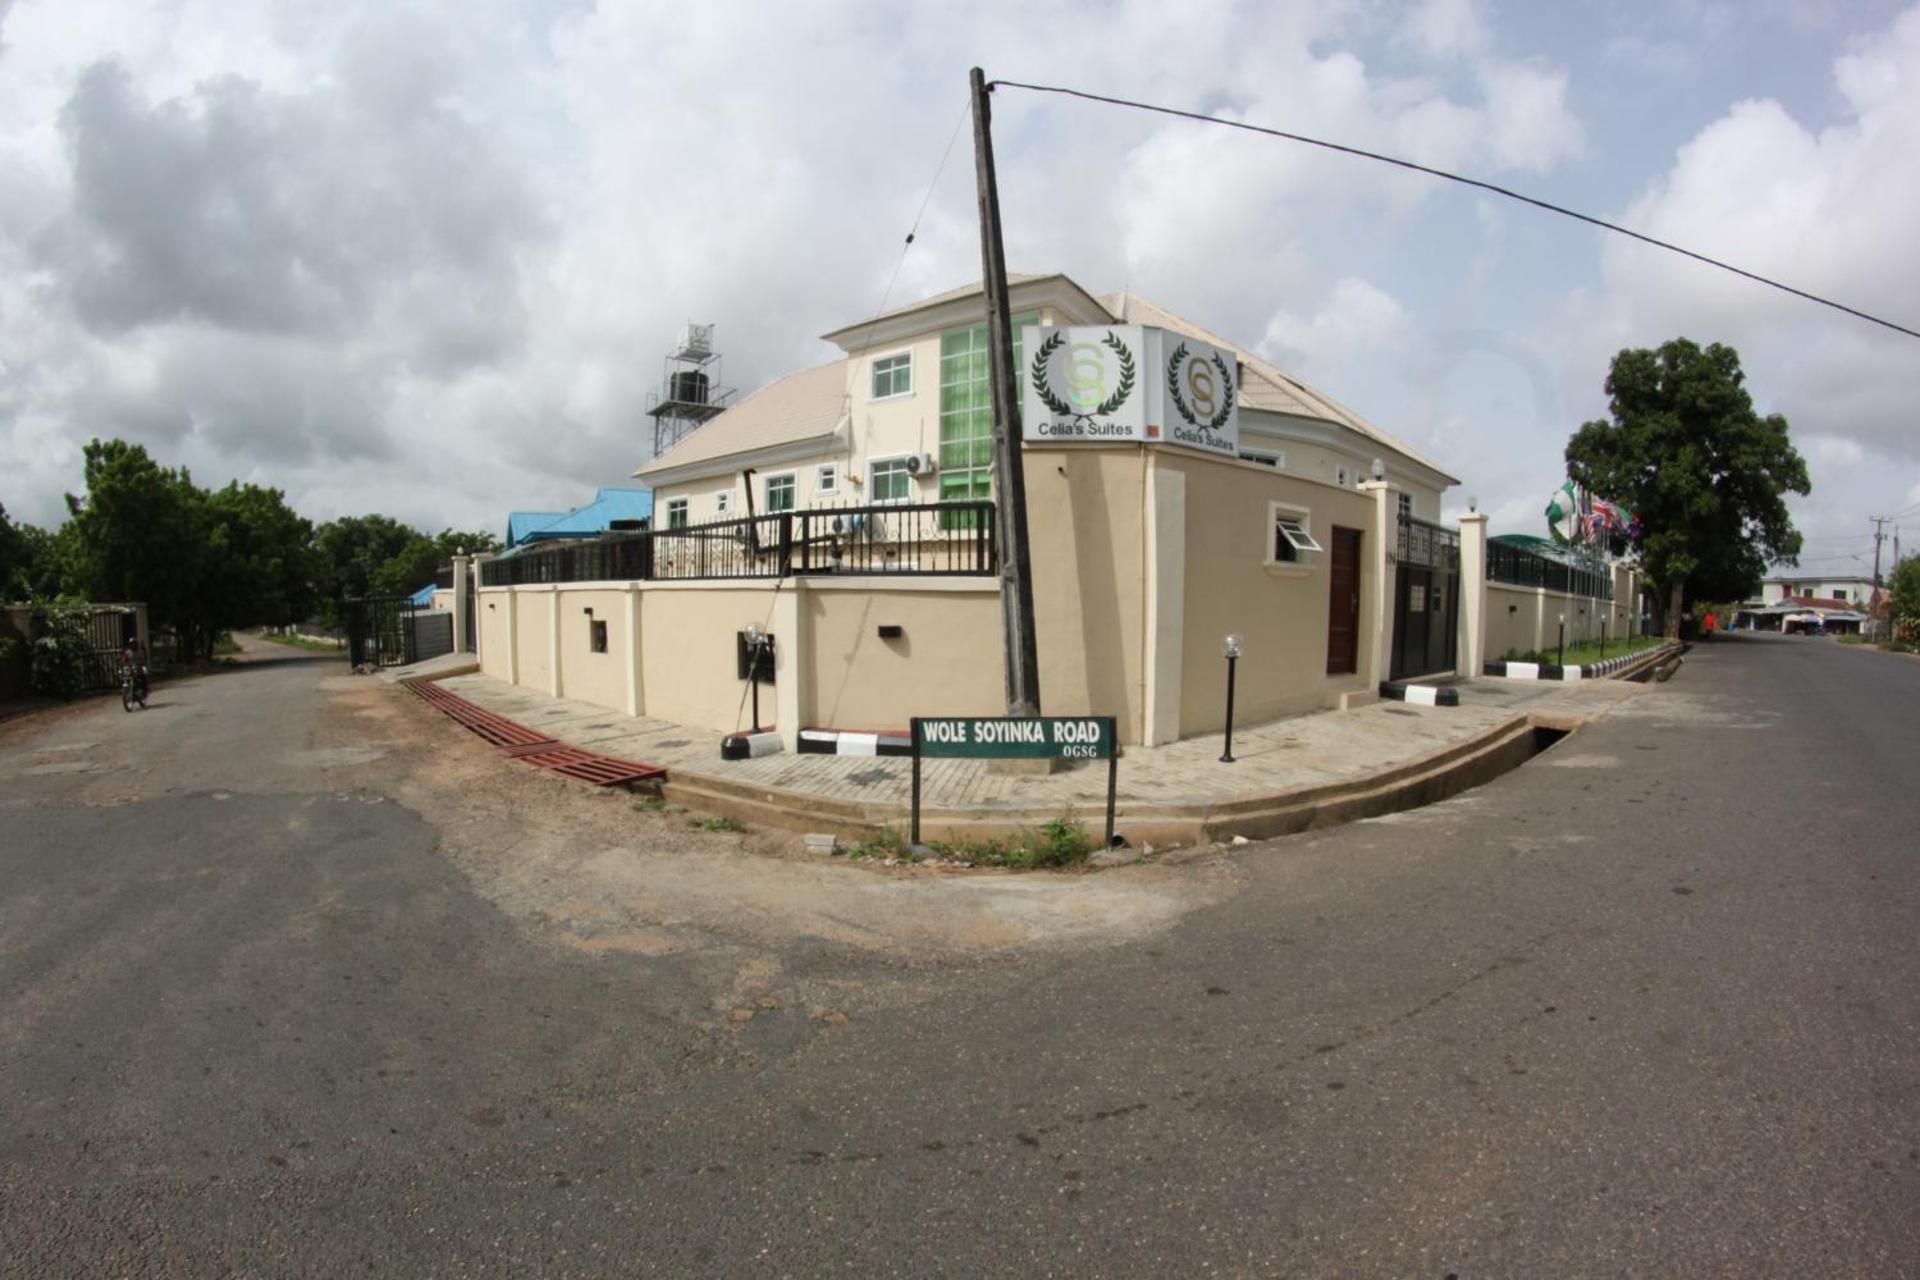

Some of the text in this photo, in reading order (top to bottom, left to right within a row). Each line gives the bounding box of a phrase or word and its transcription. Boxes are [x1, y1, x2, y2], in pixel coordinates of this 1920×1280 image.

[1038, 422, 1133, 436] Celia's Suites
[1206, 433, 1233, 451] Suites
[923, 721, 1100, 743] WOLE SOYINKA ROAD
